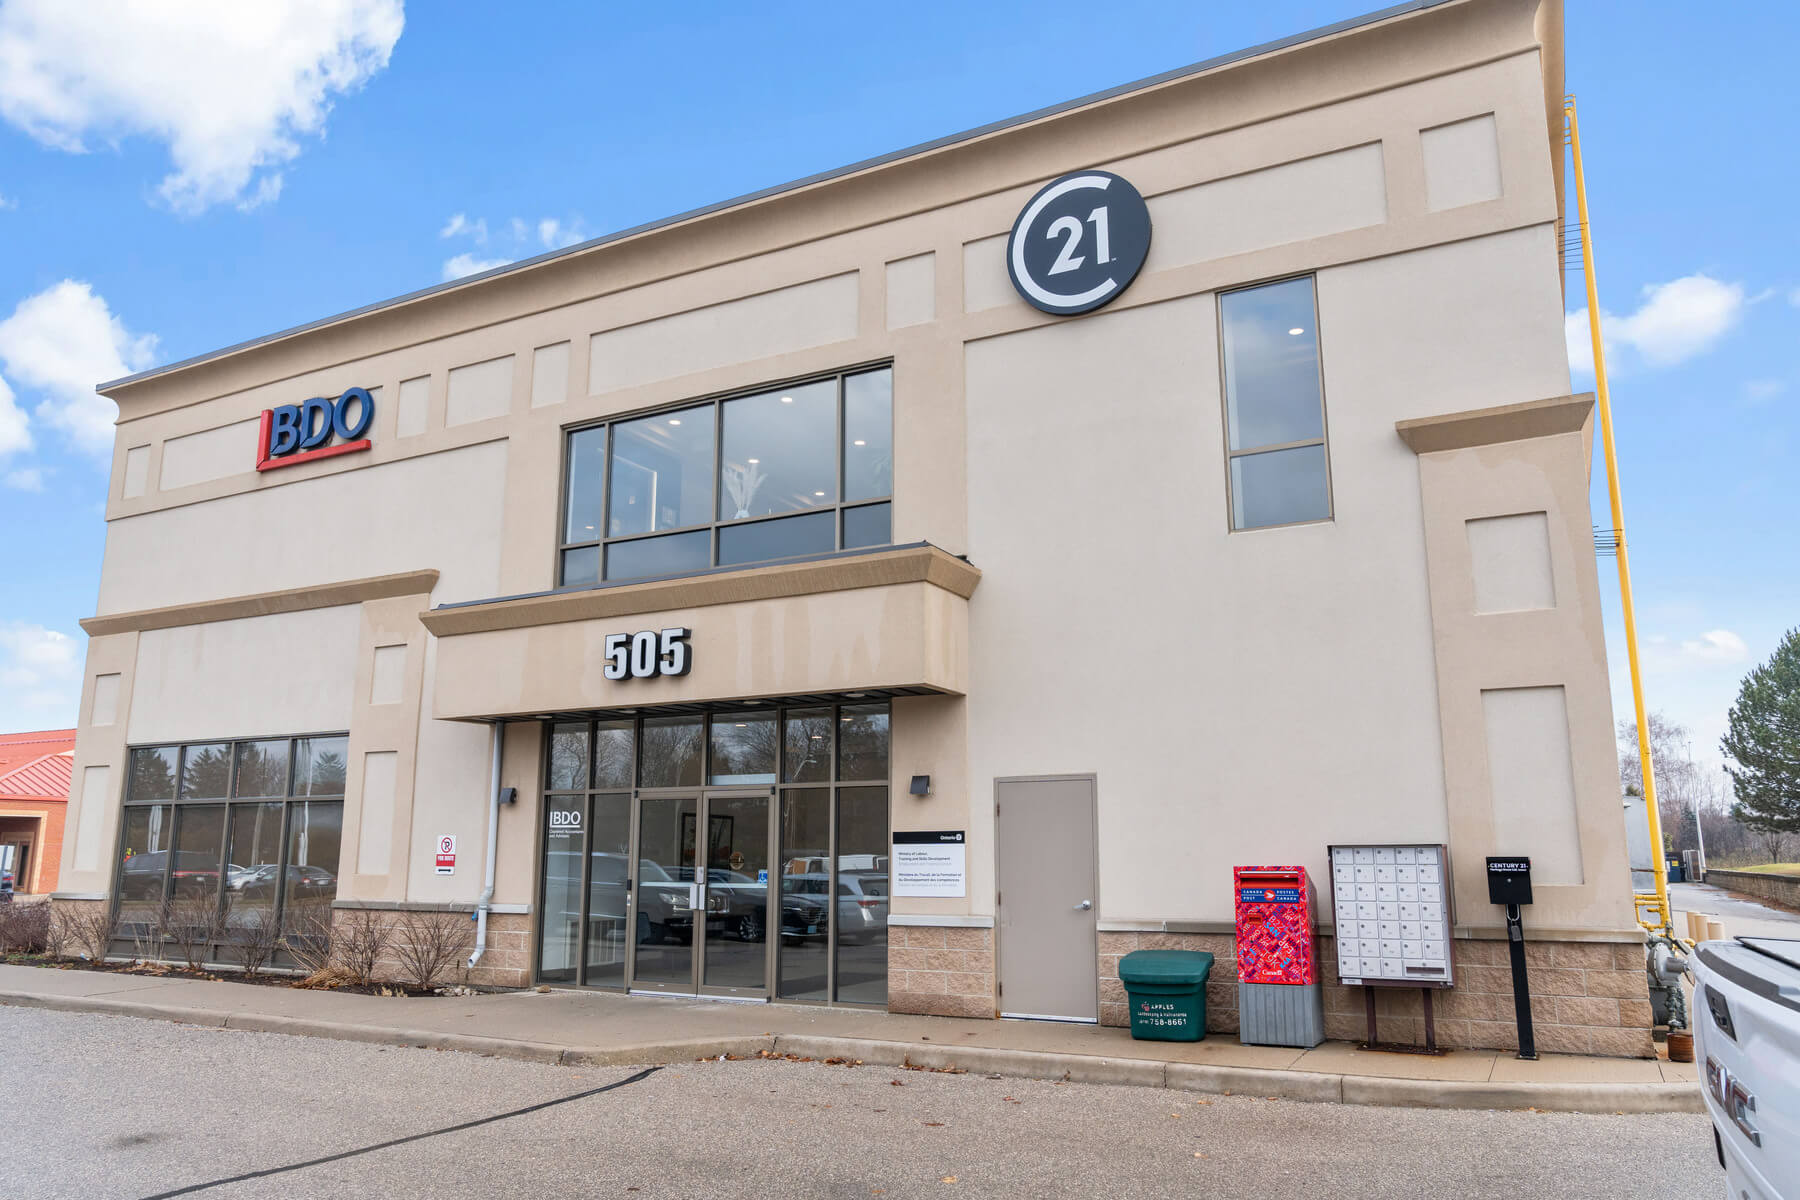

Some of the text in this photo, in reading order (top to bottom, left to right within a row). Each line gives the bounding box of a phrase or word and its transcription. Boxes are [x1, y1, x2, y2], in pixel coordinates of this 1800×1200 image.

[1046, 206, 1110, 276] 21
[268, 387, 374, 457] BDO
[604, 627, 692, 681] 505
[552, 811, 581, 825] BDO
[1150, 1018, 1187, 1026] 758-8661
